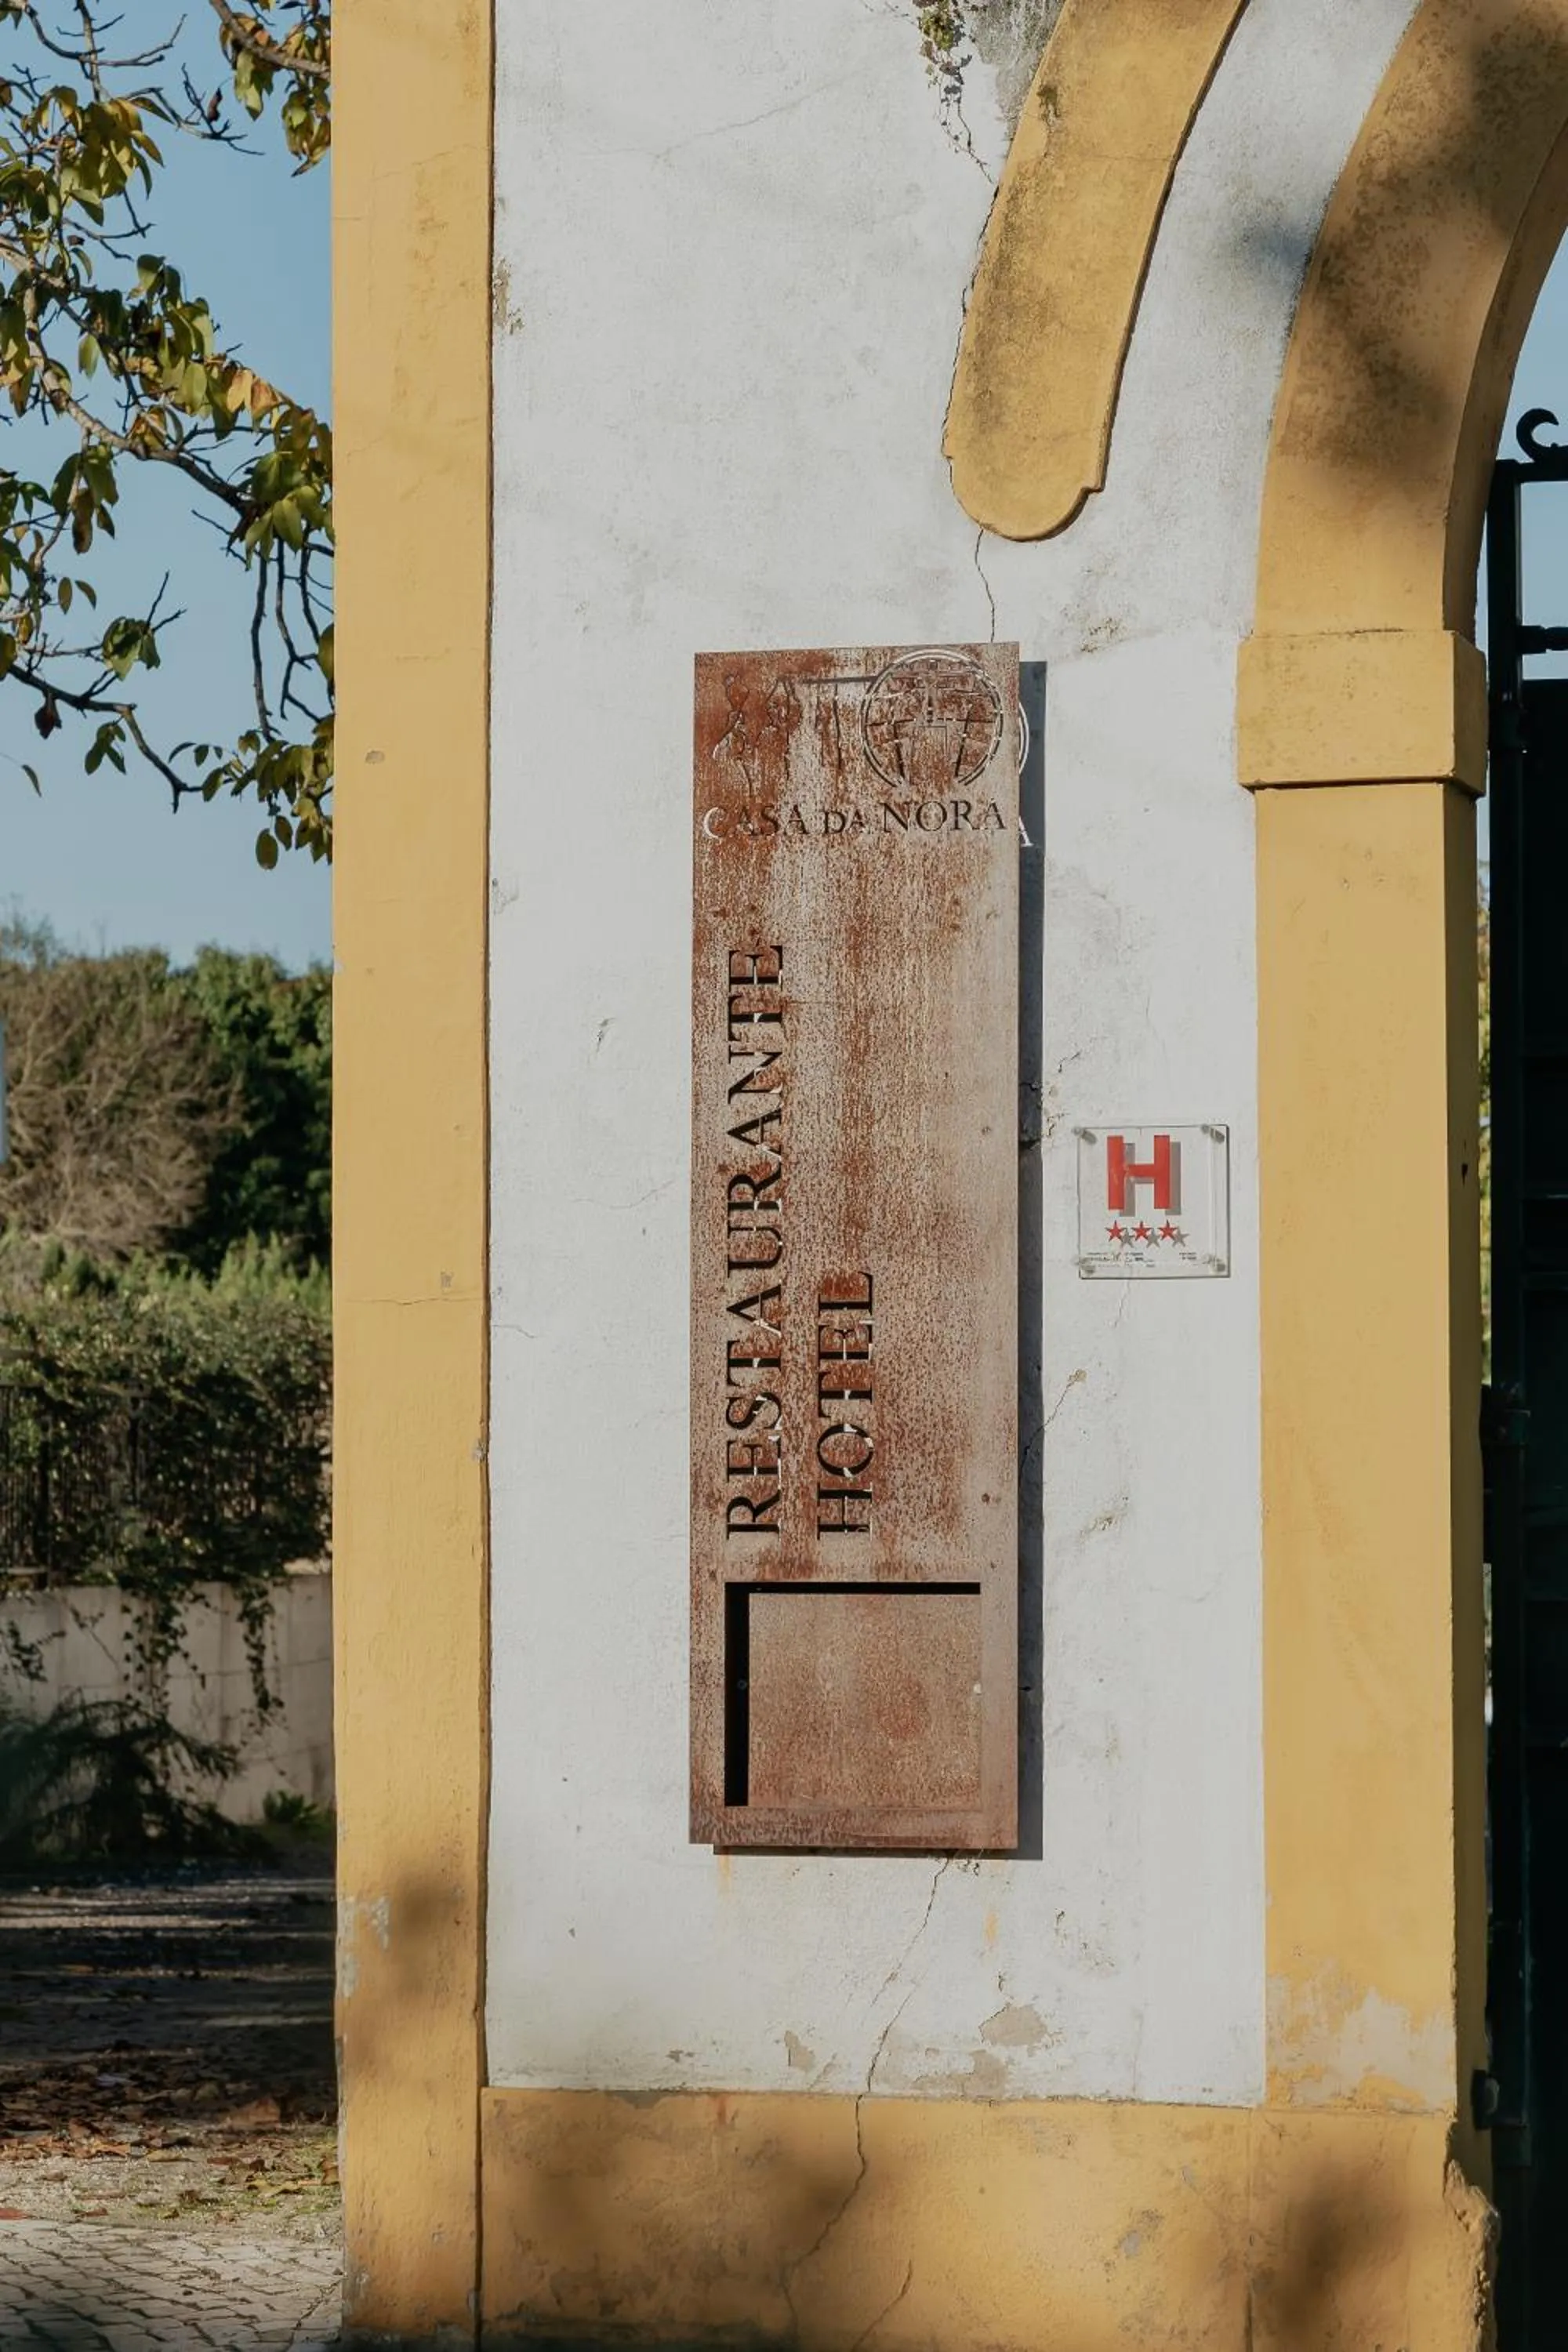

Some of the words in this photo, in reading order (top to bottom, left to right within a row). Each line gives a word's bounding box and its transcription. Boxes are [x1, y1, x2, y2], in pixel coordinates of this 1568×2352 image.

[703, 804, 810, 839] CASA
[822, 808, 866, 835] DA
[880, 798, 1007, 833] NORA
[726, 946, 783, 1540] RESTAURANTE
[1107, 1135, 1171, 1210] H
[817, 1272, 874, 1541] HOTEL
